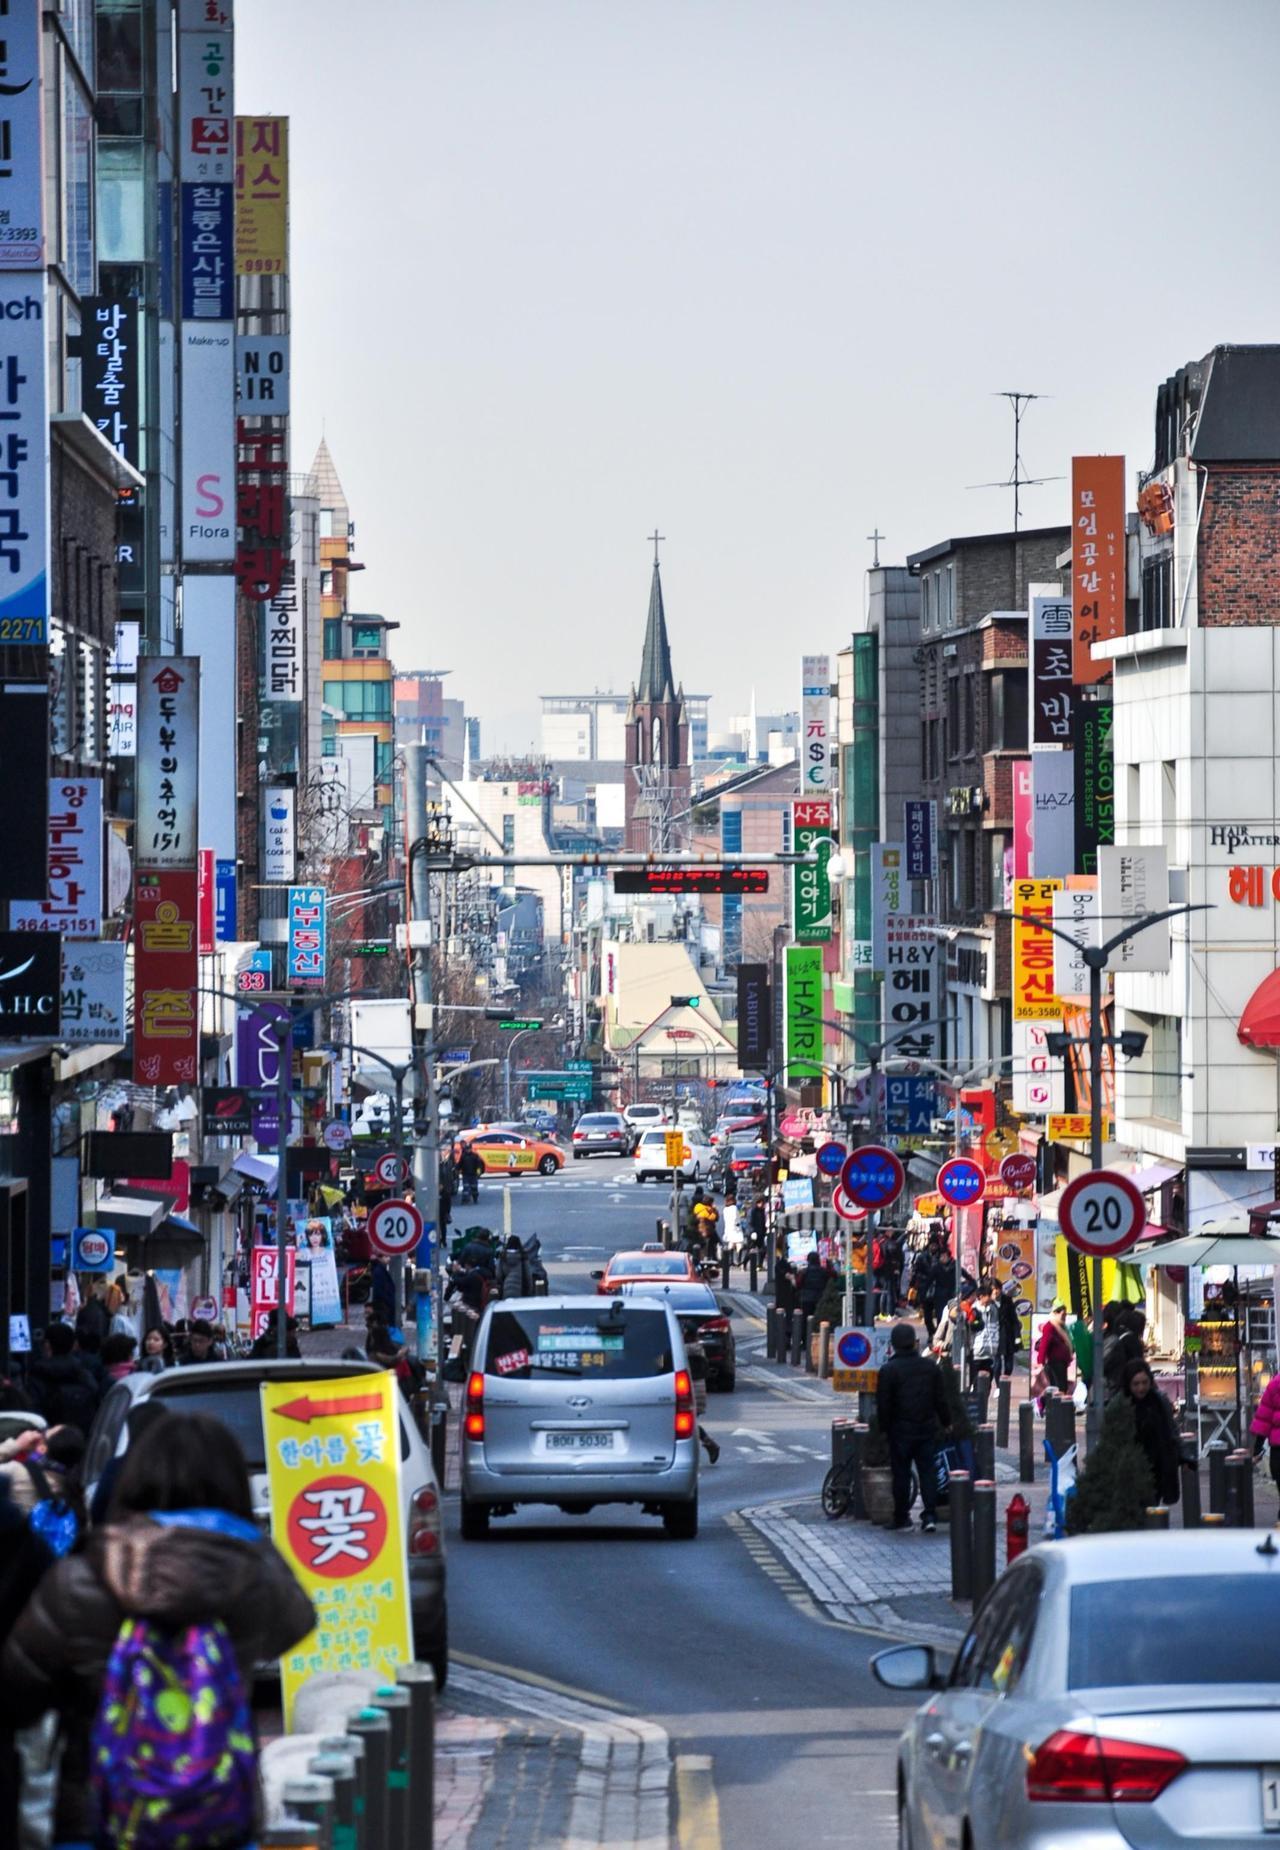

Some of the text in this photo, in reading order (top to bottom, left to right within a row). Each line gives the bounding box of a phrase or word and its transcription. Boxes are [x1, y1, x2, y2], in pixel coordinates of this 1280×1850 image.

[0, 228, 37, 240] -3393
[97, 304, 127, 405] 방탈출
[188, 335, 230, 347] Make-up
[245, 352, 283, 373] NO
[195, 474, 224, 517] S
[190, 525, 230, 539] Flora
[1077, 490, 1102, 593] 모임공간
[1041, 604, 1073, 634] 雪
[1084, 721, 1094, 765] COFFEE
[1097, 707, 1113, 841] MANGO SIX
[795, 804, 830, 825] 사주
[1084, 779, 1094, 828] DESSERT
[153, 833, 180, 850] 151
[799, 831, 821, 918] 인이야기
[17, 919, 97, 931] 364-5151
[294, 906, 322, 973] 부동산
[1021, 905, 1054, 1003] 부동산
[793, 980, 816, 1048] HAIR
[1017, 1007, 1061, 1017] 365-3580
[384, 1217, 408, 1239] 20
[1084, 1196, 1122, 1232] 20
[355, 1422, 385, 1463] 꽃
[299, 1485, 376, 1566] 꽃
